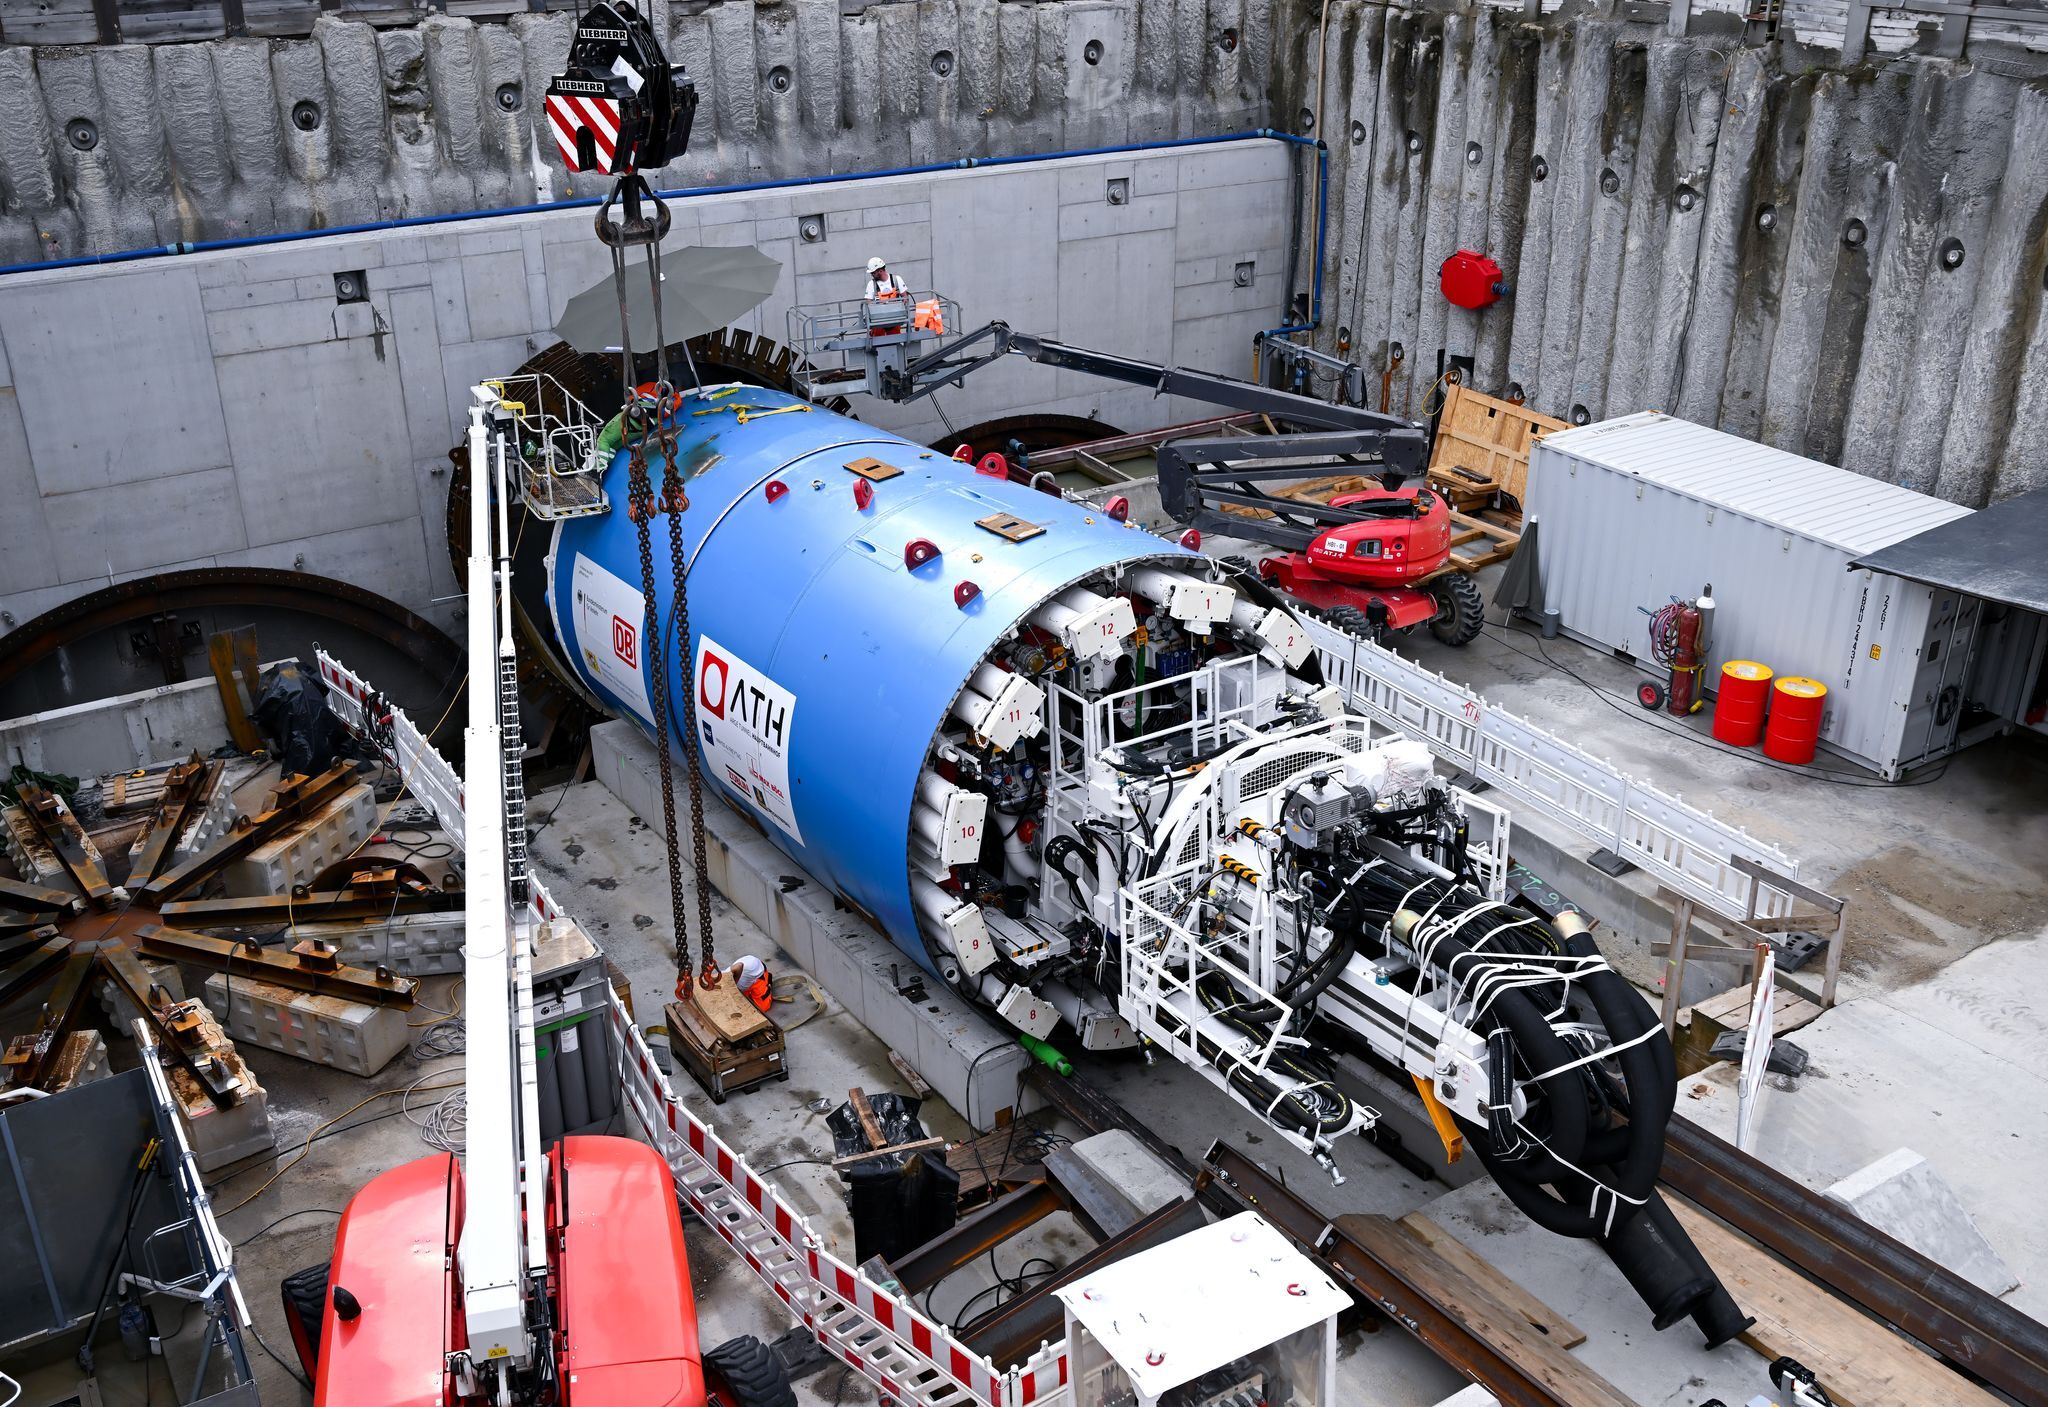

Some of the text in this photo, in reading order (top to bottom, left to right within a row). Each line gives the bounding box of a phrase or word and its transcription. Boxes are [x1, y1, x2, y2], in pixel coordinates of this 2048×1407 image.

[580, 28, 627, 39] LIEBHERR
[557, 81, 604, 92] LIEBHERR
[1206, 598, 1211, 610] 1
[1858, 587, 1868, 622] KBRU
[1880, 595, 1890, 631] 22G1
[1101, 622, 1114, 636] 12
[615, 622, 634, 661] DB
[1287, 636, 1294, 647] 2
[1847, 624, 1861, 676] 244314
[730, 679, 785, 747] ATH
[1009, 709, 1020, 723] 11
[961, 826, 975, 839] 10
[972, 939, 979, 950] 9
[1030, 1009, 1036, 1020] 8
[1114, 1028, 1120, 1038] 7
